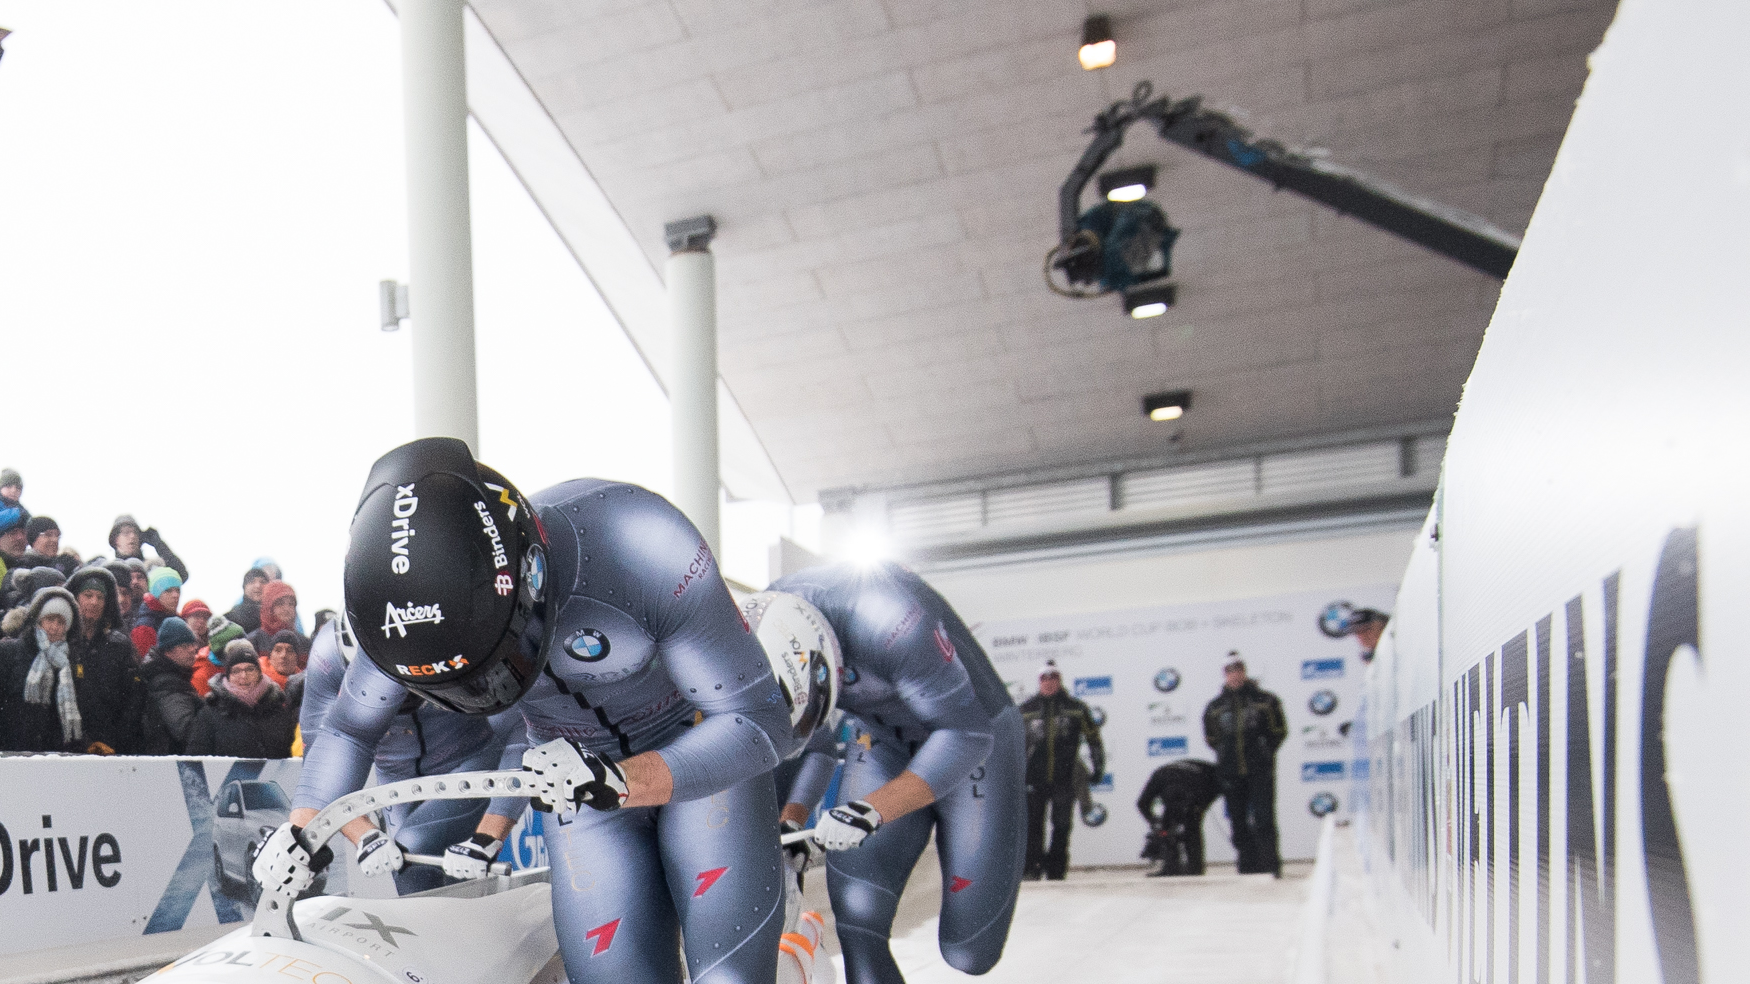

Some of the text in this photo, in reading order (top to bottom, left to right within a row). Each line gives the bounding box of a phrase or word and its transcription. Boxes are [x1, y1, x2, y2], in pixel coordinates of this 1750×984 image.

[391, 483, 418, 574] xDrive
[474, 501, 508, 569] Binders
[396, 661, 450, 676] RECK
[305, 922, 394, 957] AIRPORT
